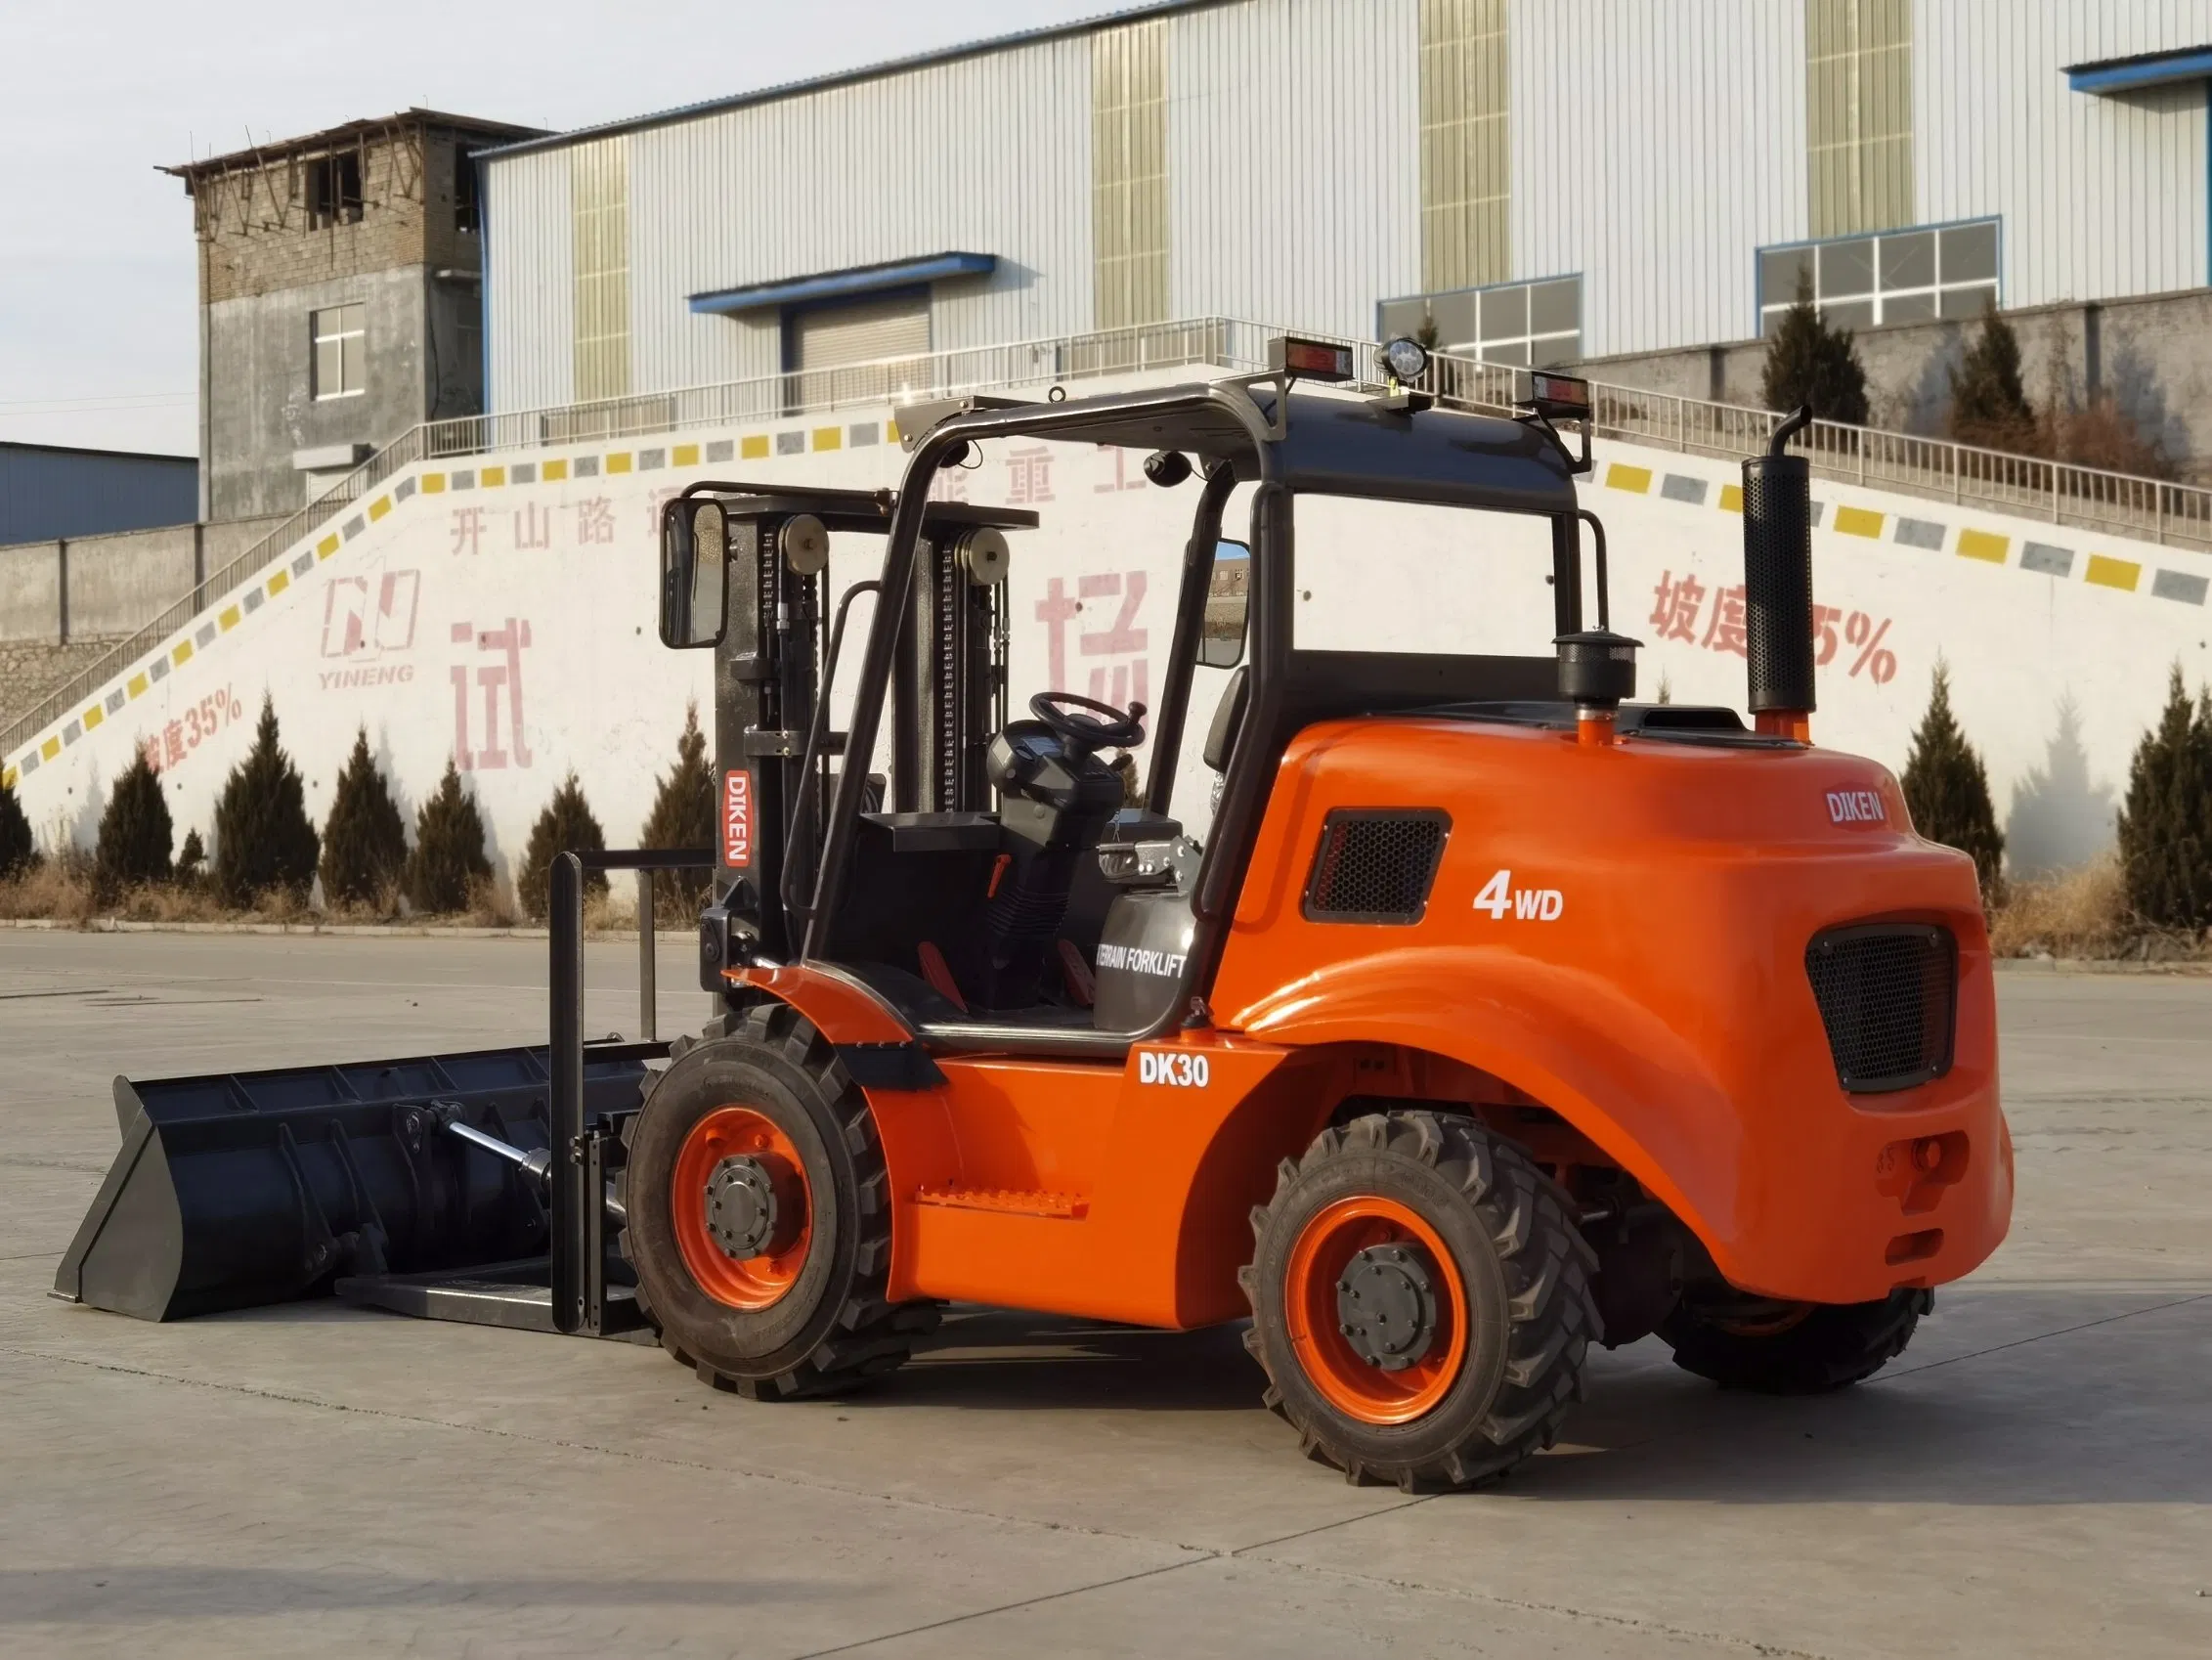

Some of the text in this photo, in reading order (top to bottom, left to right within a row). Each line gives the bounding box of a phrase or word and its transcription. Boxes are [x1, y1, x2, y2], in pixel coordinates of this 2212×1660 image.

[1649, 569, 1896, 684] 坡度5%
[318, 665, 414, 690] YINENG
[728, 776, 747, 859] DIKEN
[1826, 791, 1885, 822] DIKEN
[1472, 869, 1563, 920] 4WD
[1125, 947, 1188, 979] FORKLIFT
[1140, 1051, 1209, 1087] DK30
